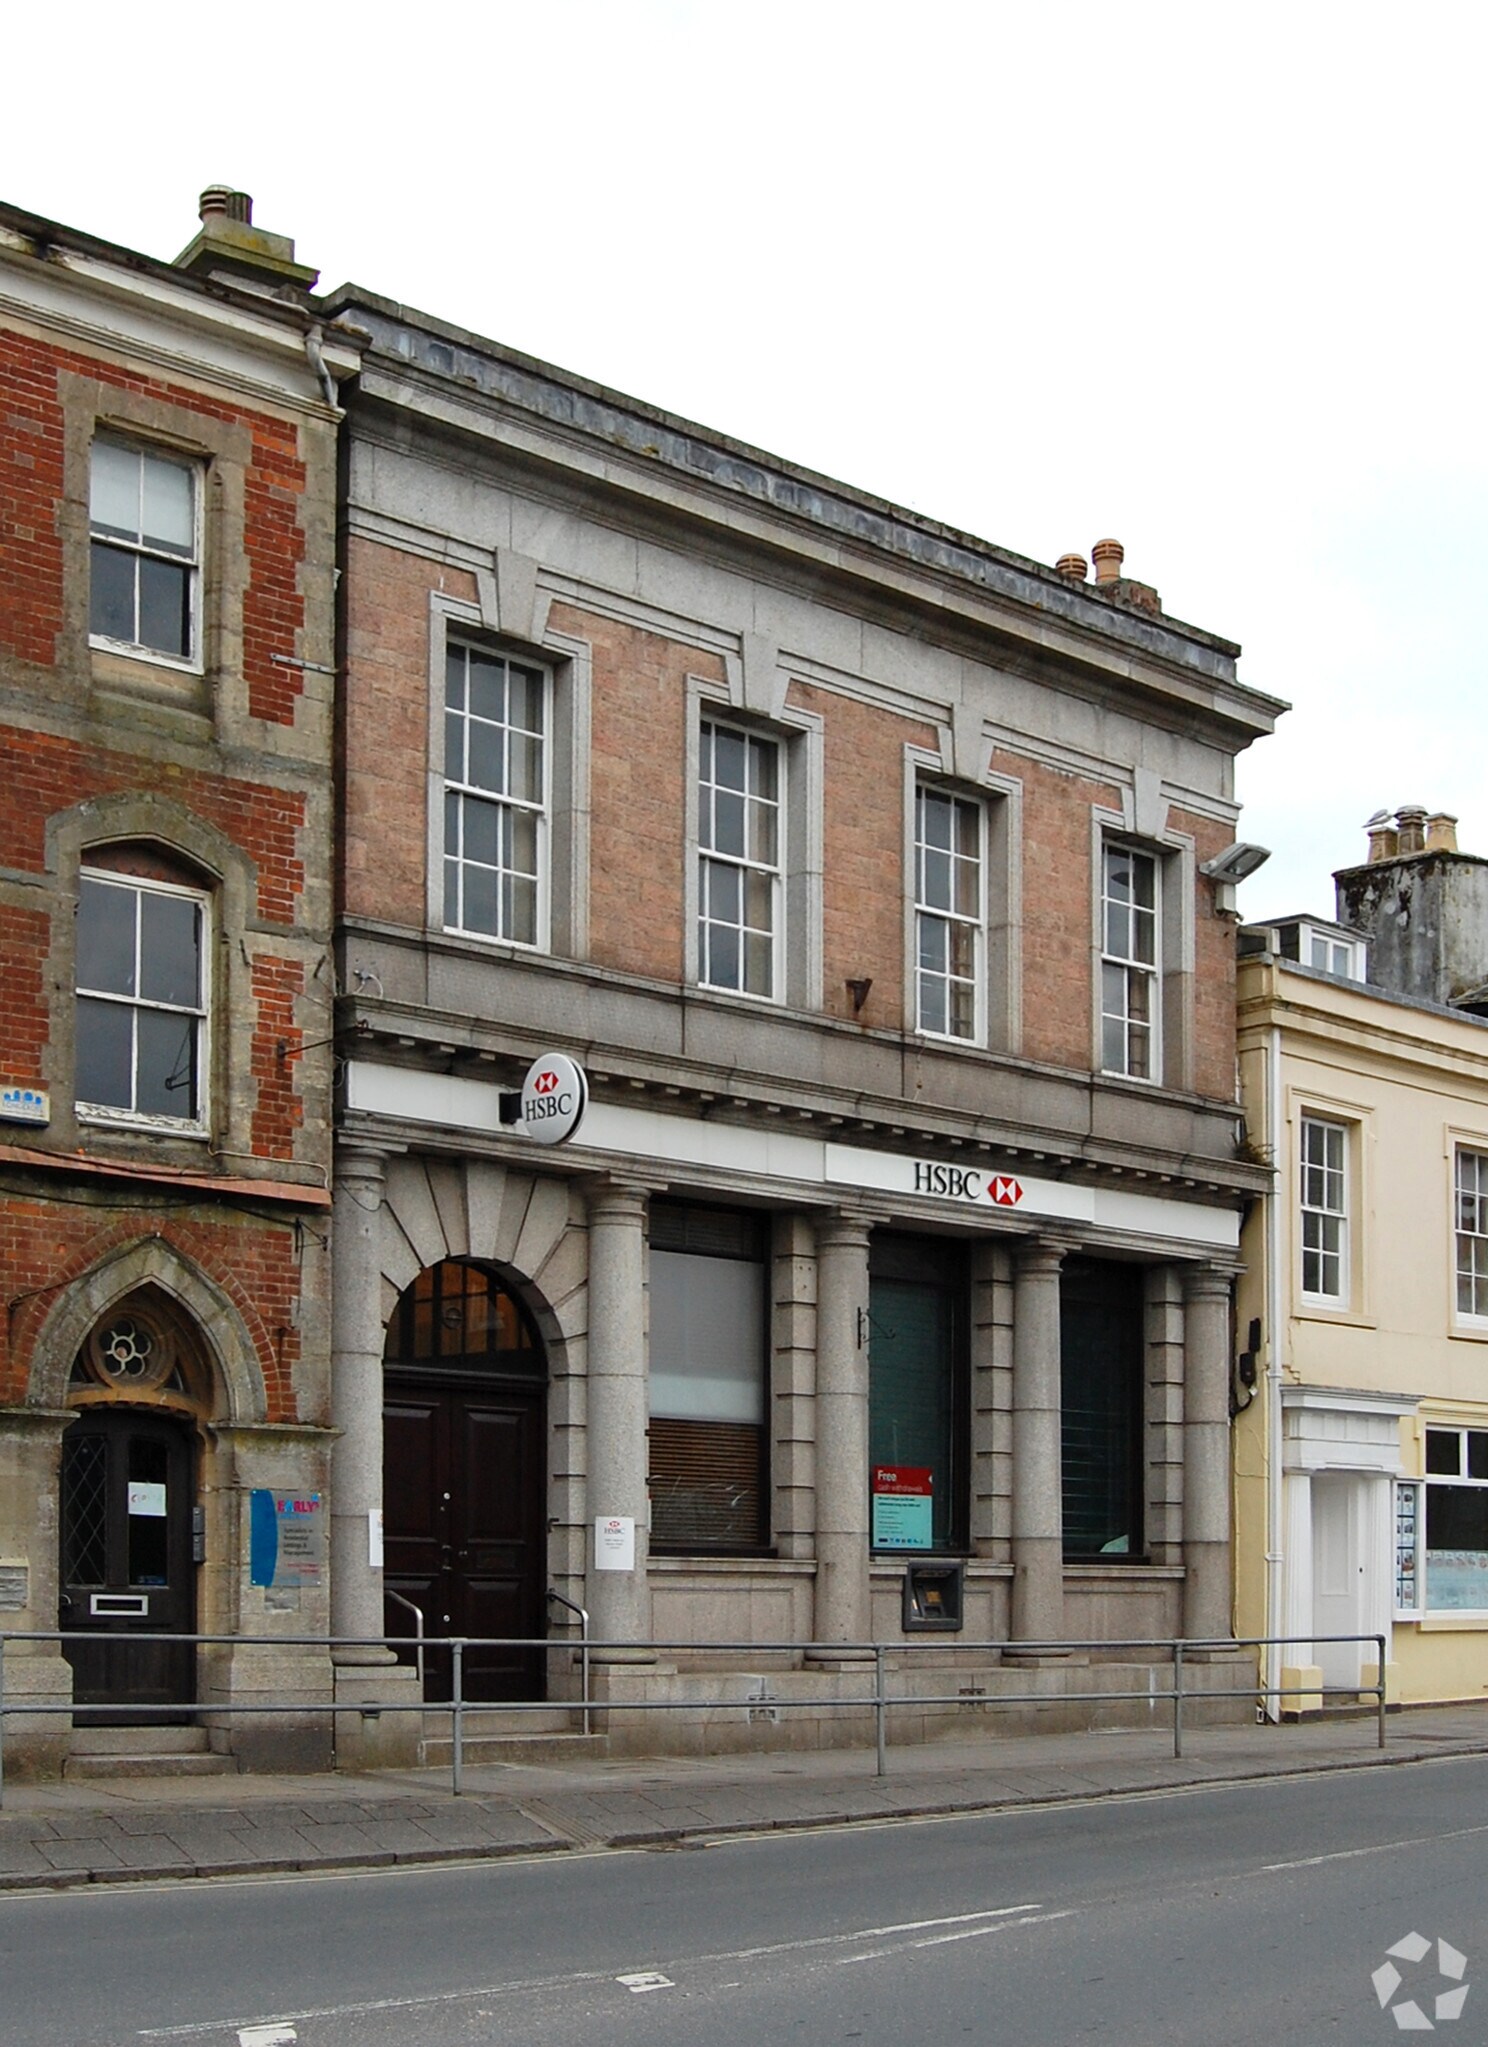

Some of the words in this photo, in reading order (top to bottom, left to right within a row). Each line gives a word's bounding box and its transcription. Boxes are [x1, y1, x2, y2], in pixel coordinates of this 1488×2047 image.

[525, 1093, 572, 1121] HSBC
[914, 1162, 980, 1199] HSBC
[877, 1470, 897, 1481] Free
